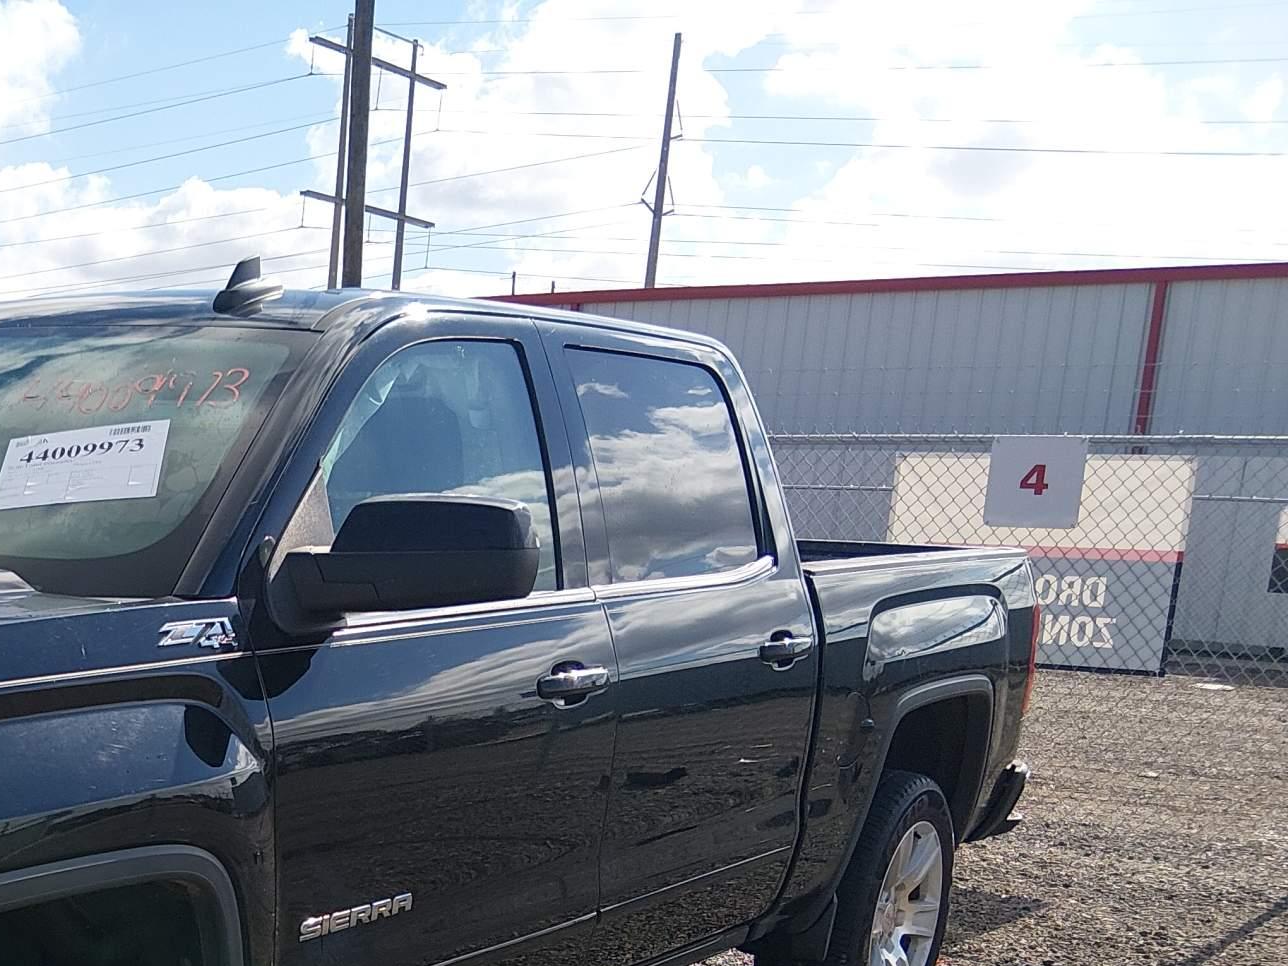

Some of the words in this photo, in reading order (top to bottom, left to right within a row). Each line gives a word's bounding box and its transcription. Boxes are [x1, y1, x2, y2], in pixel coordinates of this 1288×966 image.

[19, 438, 144, 464] 44009973
[1019, 464, 1048, 495] 4
[299, 892, 413, 942] SIERRA
